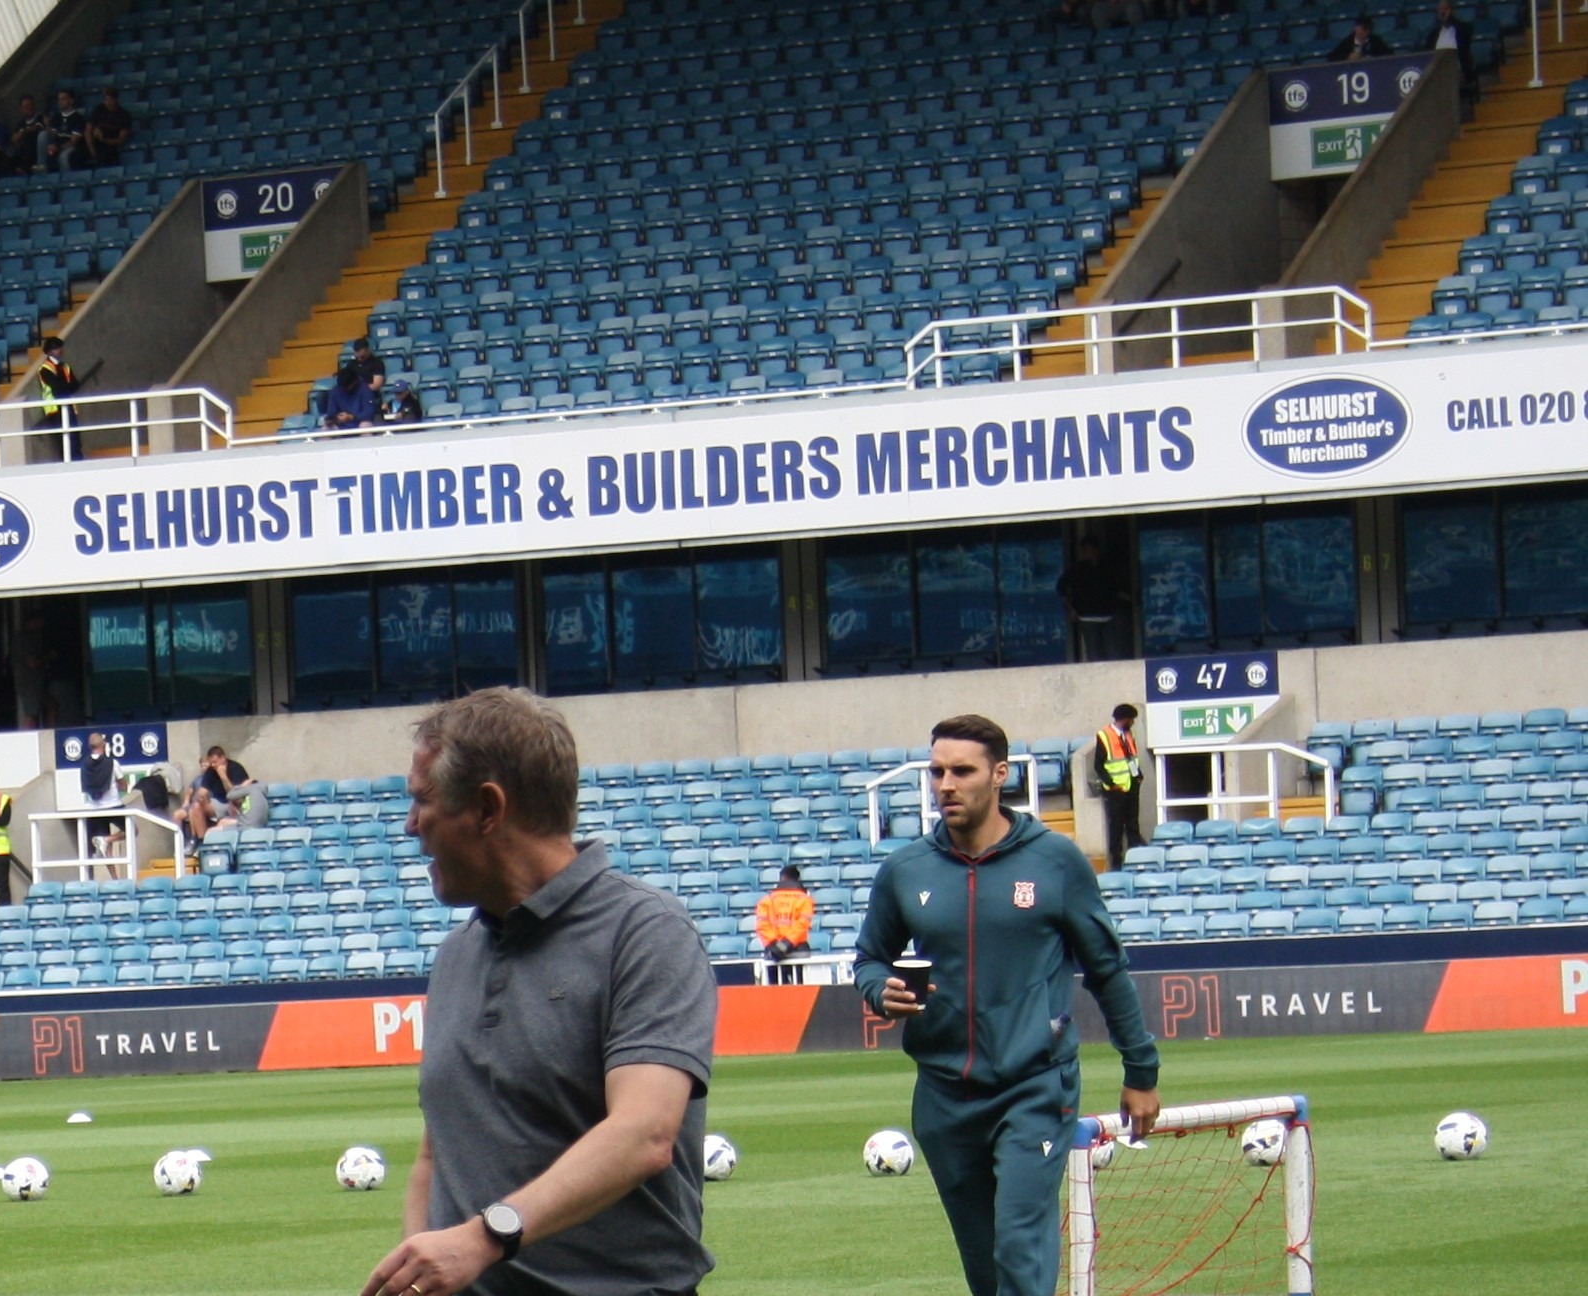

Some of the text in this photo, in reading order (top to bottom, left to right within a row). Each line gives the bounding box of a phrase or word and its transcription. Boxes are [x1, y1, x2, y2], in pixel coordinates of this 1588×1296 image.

[1337, 71, 1370, 105] 19
[1317, 140, 1343, 153] EXIT
[258, 182, 294, 214] 20
[245, 245, 268, 259] EXIT
[1274, 391, 1378, 424] SELHURST
[1446, 396, 1513, 432] CALL
[1519, 390, 1576, 426] 020
[1260, 419, 1395, 447] Timber & Builder's
[1288, 441, 1368, 465] Merchants
[73, 405, 1196, 556] SELHURST TIMBER & BUILDERS MERCHANTS
[1196, 662, 1227, 690] 47
[1183, 717, 1205, 729] EXIT
[1160, 974, 1382, 1038] P1 TRAVEL
[32, 1015, 221, 1075] P1 TRAVEL
